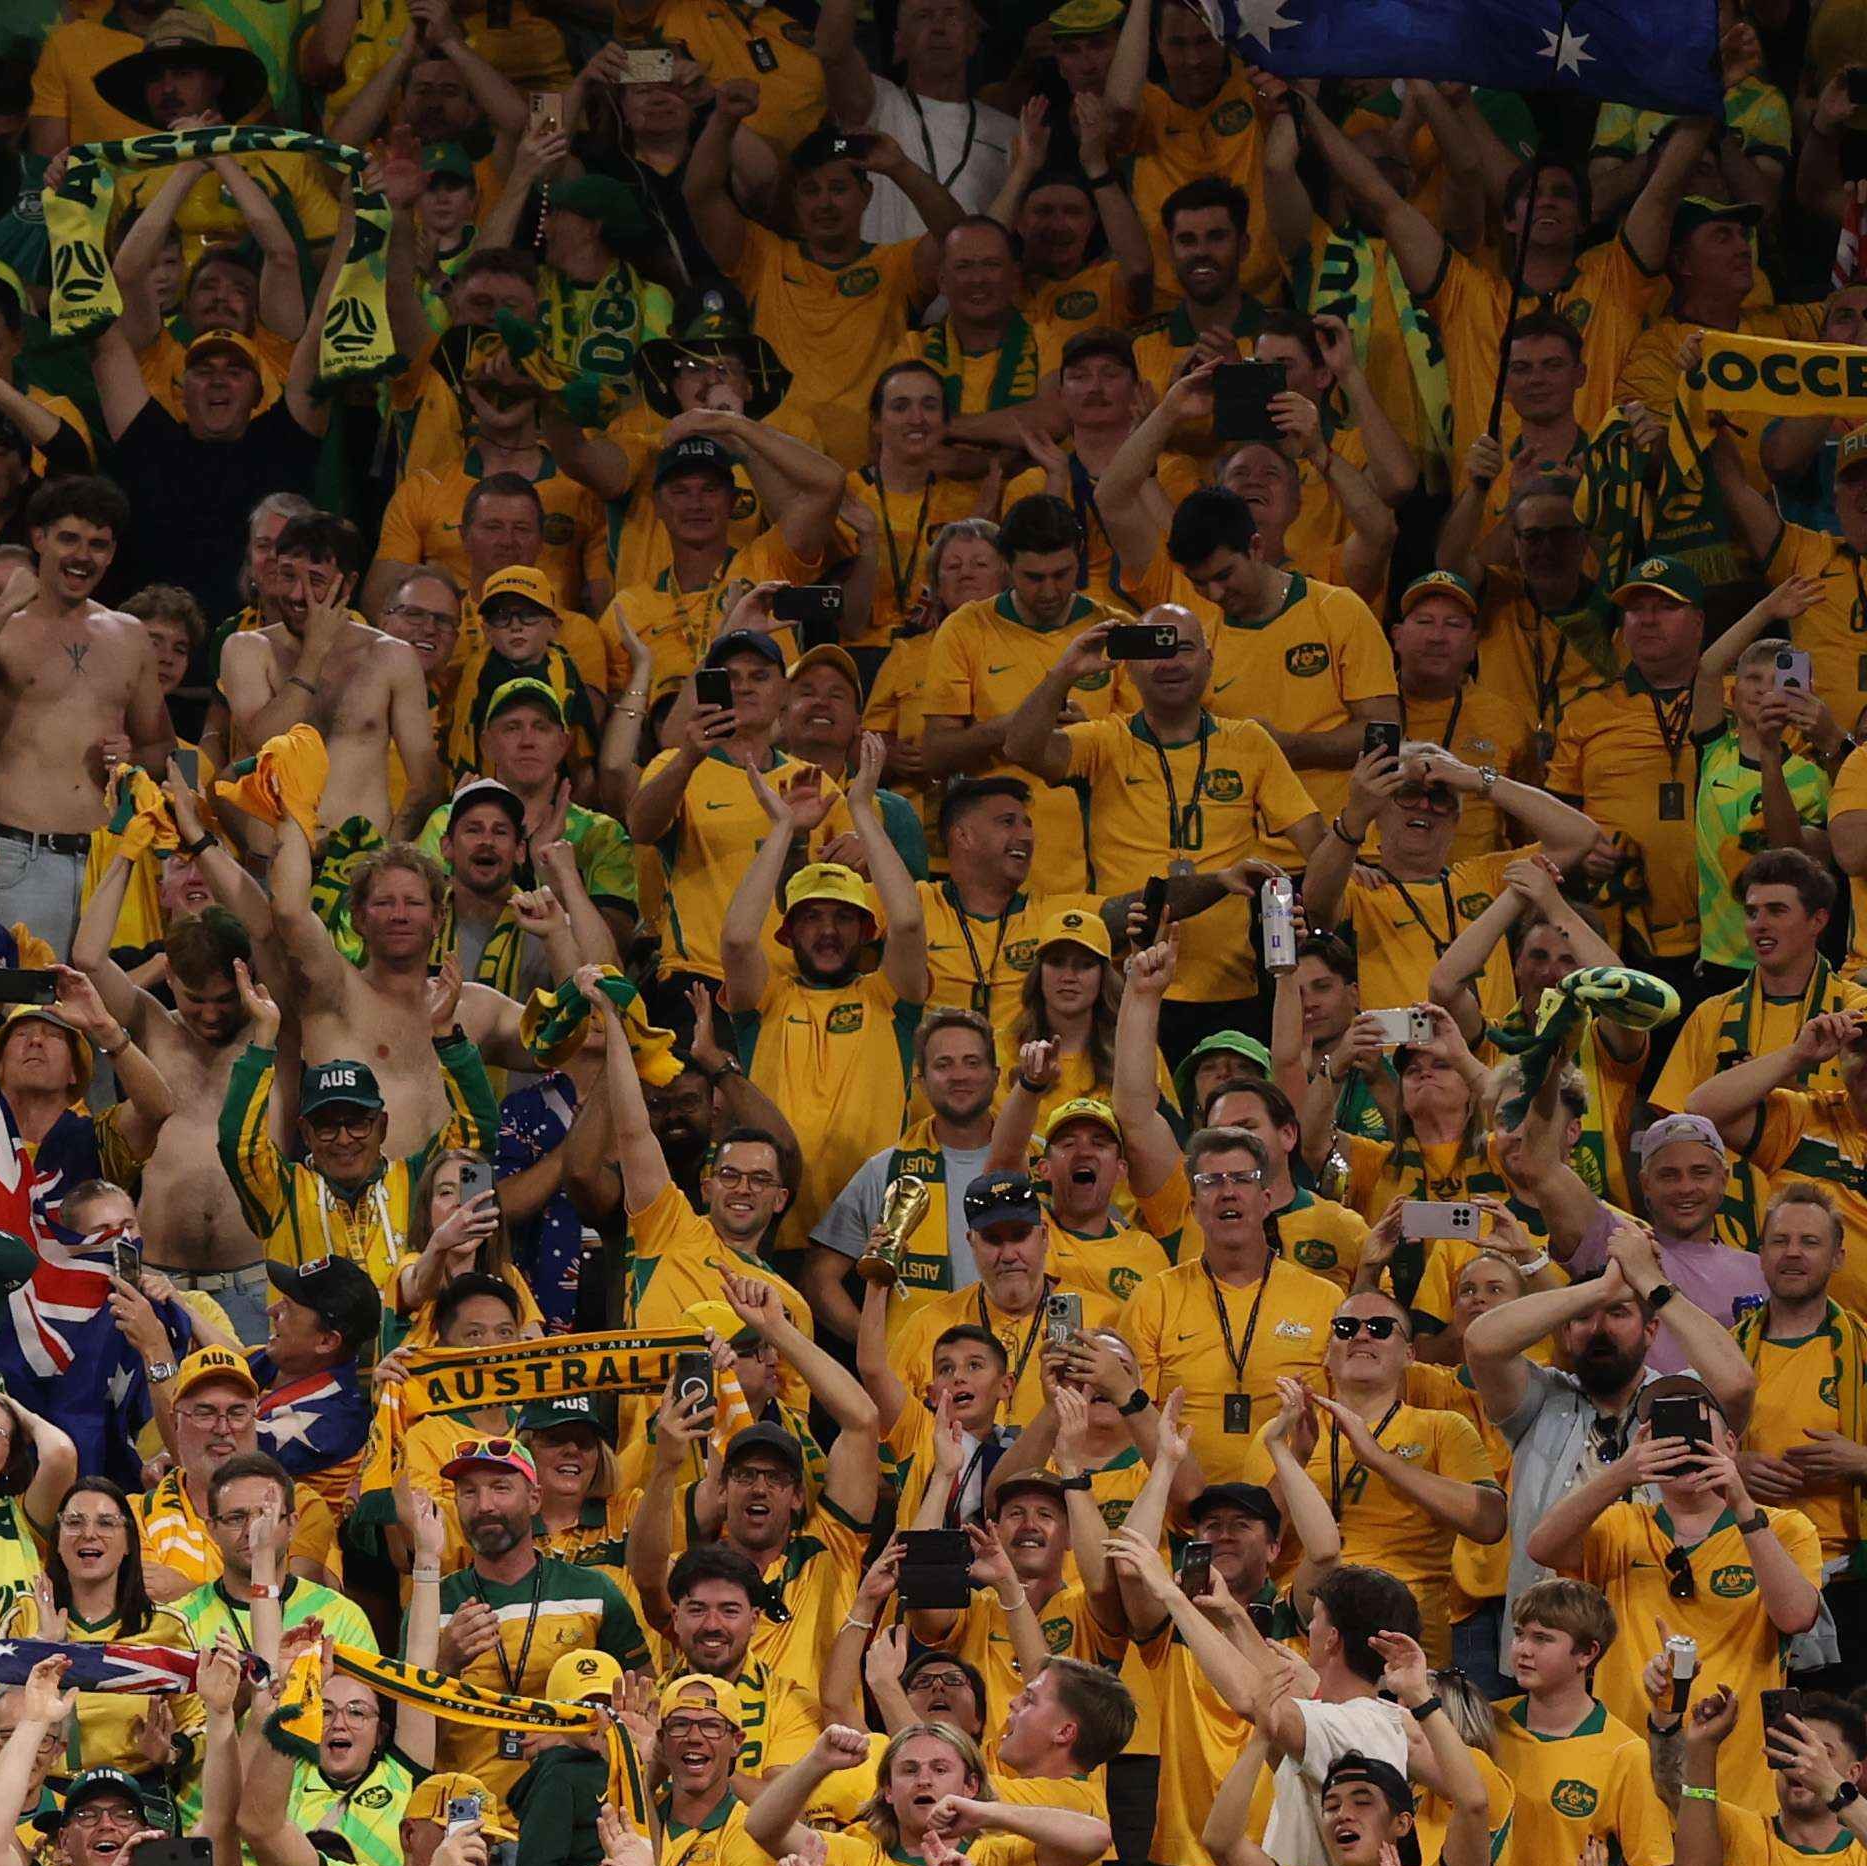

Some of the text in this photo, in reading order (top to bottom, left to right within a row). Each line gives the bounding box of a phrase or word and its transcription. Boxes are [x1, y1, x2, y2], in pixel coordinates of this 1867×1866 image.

[677, 439, 716, 457] AUS
[318, 1068, 357, 1091] AUS
[607, 1336, 653, 1351] ARMY
[200, 1351, 236, 1370] AUS
[424, 1351, 678, 1406] AUSTRALI
[551, 1396, 590, 1412] AUS
